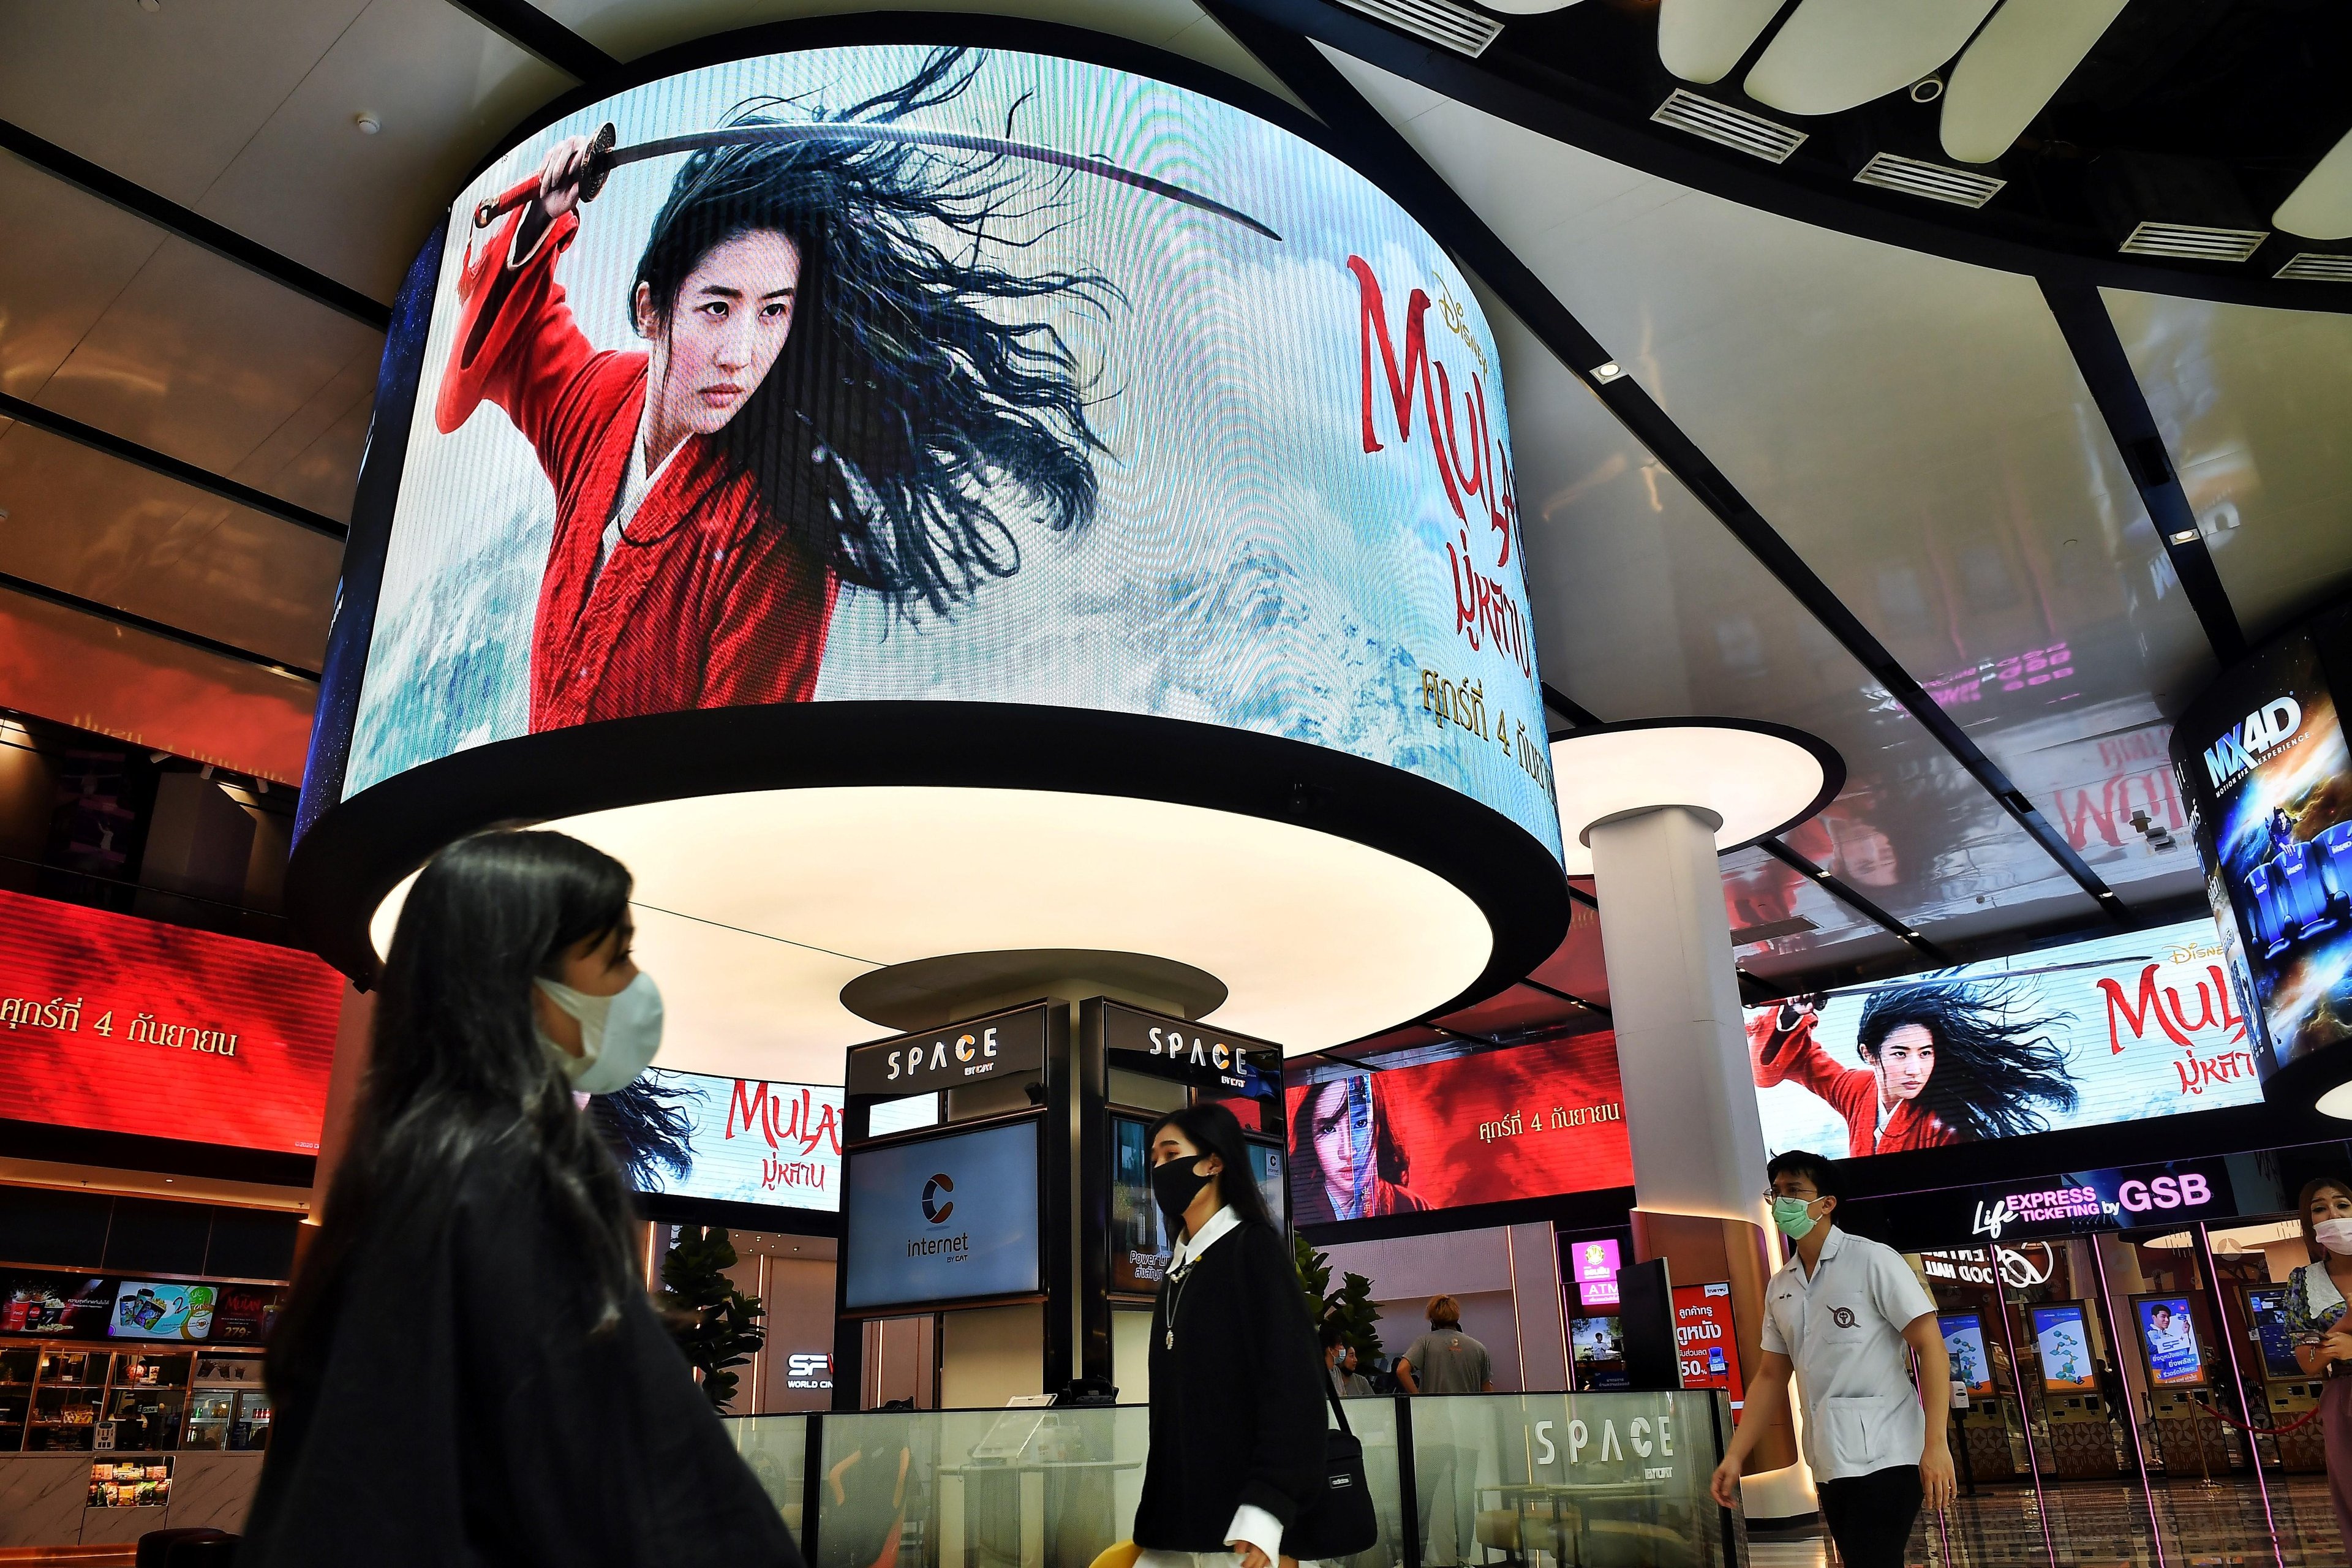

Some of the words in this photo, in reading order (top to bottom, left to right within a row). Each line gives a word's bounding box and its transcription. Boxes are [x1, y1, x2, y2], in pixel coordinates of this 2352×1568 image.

[1422, 668, 1489, 742] ศุกร์ที่
[1496, 709, 1511, 758] 4
[2203, 696, 2302, 789] MX4D
[2215, 776, 2237, 799] MOTION
[2237, 767, 2249, 781] EFX
[2257, 731, 2310, 766] EXPERIENCE
[2162, 943, 2224, 965] Disne
[0, 997, 83, 1032] ศุกร์ที่
[93, 1010, 113, 1037] 4
[127, 1012, 238, 1057] กันยายน
[887, 1027, 997, 1080] SPACE
[1148, 1027, 1248, 1075] SPACE
[2173, 1049, 2255, 1095] มู่หลา
[1479, 1109, 1523, 1144] ศุกร์ที่
[1530, 1112, 1543, 1132] 4
[1551, 1102, 1621, 1129] กันยายน
[761, 1152, 824, 1192] มู่หลาน
[1972, 1200, 2019, 1239] Life
[2005, 1186, 2097, 1211] EXPRESS
[2019, 1201, 2100, 1223] TICKETING
[2101, 1200, 2120, 1216] by
[2118, 1173, 2212, 1212] GSB
[907, 1231, 968, 1257] internet
[1129, 1250, 1157, 1265] Power
[1589, 1283, 1618, 1295] ATM
[1679, 1305, 1713, 1319] ลูกค้าทรู
[1676, 1320, 1722, 1346] ดูหนัง
[787, 1380, 818, 1389] WORLD
[1534, 1416, 1673, 1465] SPACE
